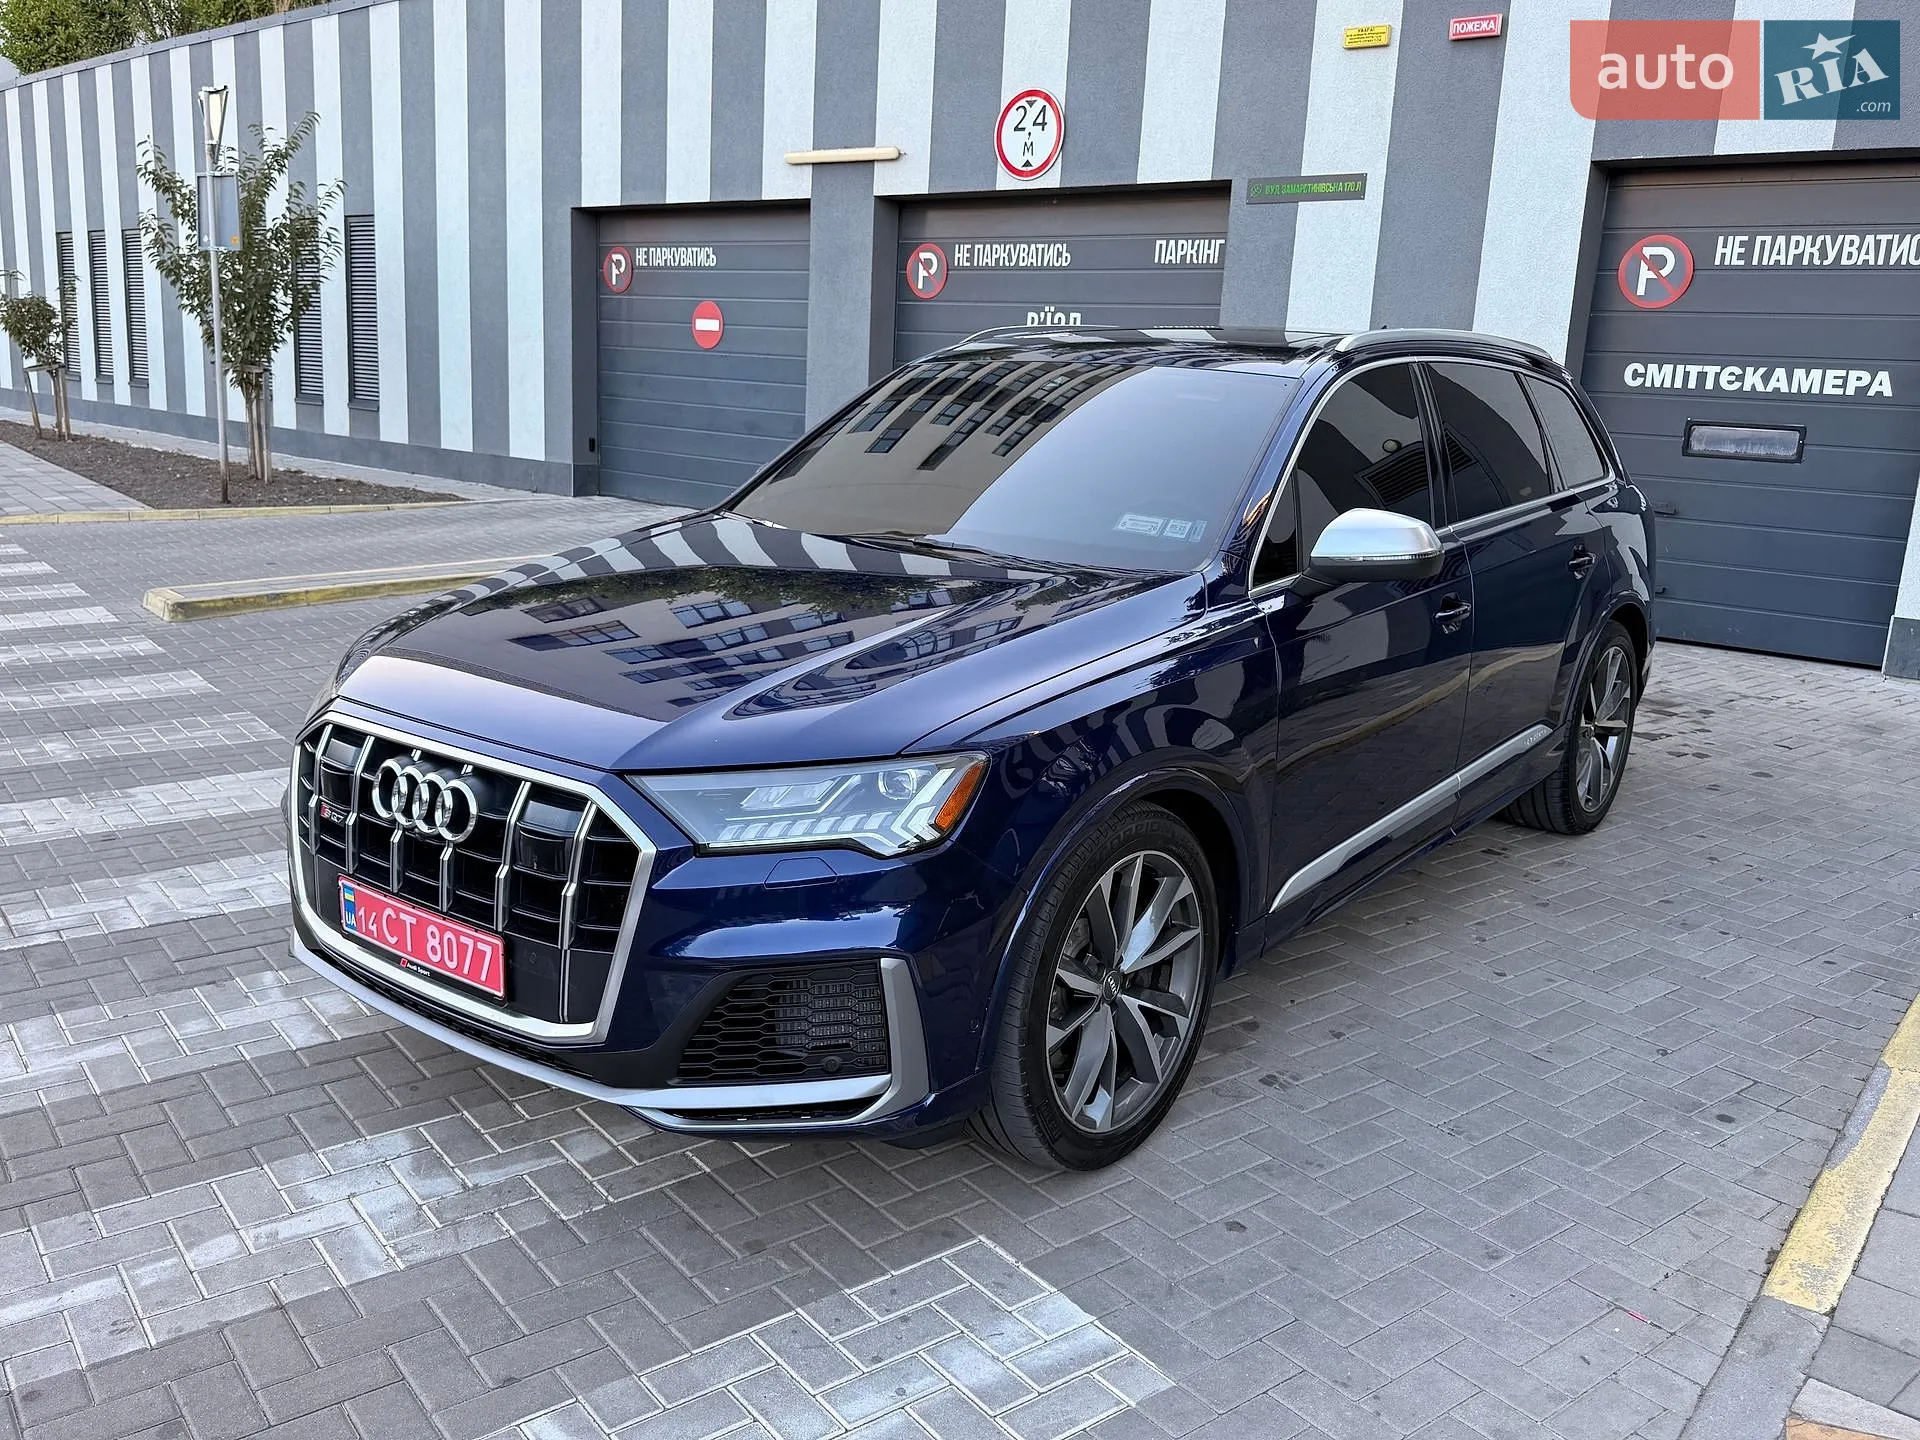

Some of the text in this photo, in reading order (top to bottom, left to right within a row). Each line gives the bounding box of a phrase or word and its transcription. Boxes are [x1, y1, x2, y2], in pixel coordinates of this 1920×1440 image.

[1452, 20, 1495, 34] ПОЖЕЖА
[635, 246, 717, 267] НЕ ПАРКУВАТИСЬ
[954, 243, 1071, 268] НЕ ПАРКУВАТИСЬ
[1154, 239, 1225, 264] ПАРКІНГ
[1713, 235, 1749, 266] НЕ
[1623, 362, 1893, 397] СМІТТЄКАМЕРА
[345, 912, 357, 928] UA
[426, 925, 493, 982] 8077
